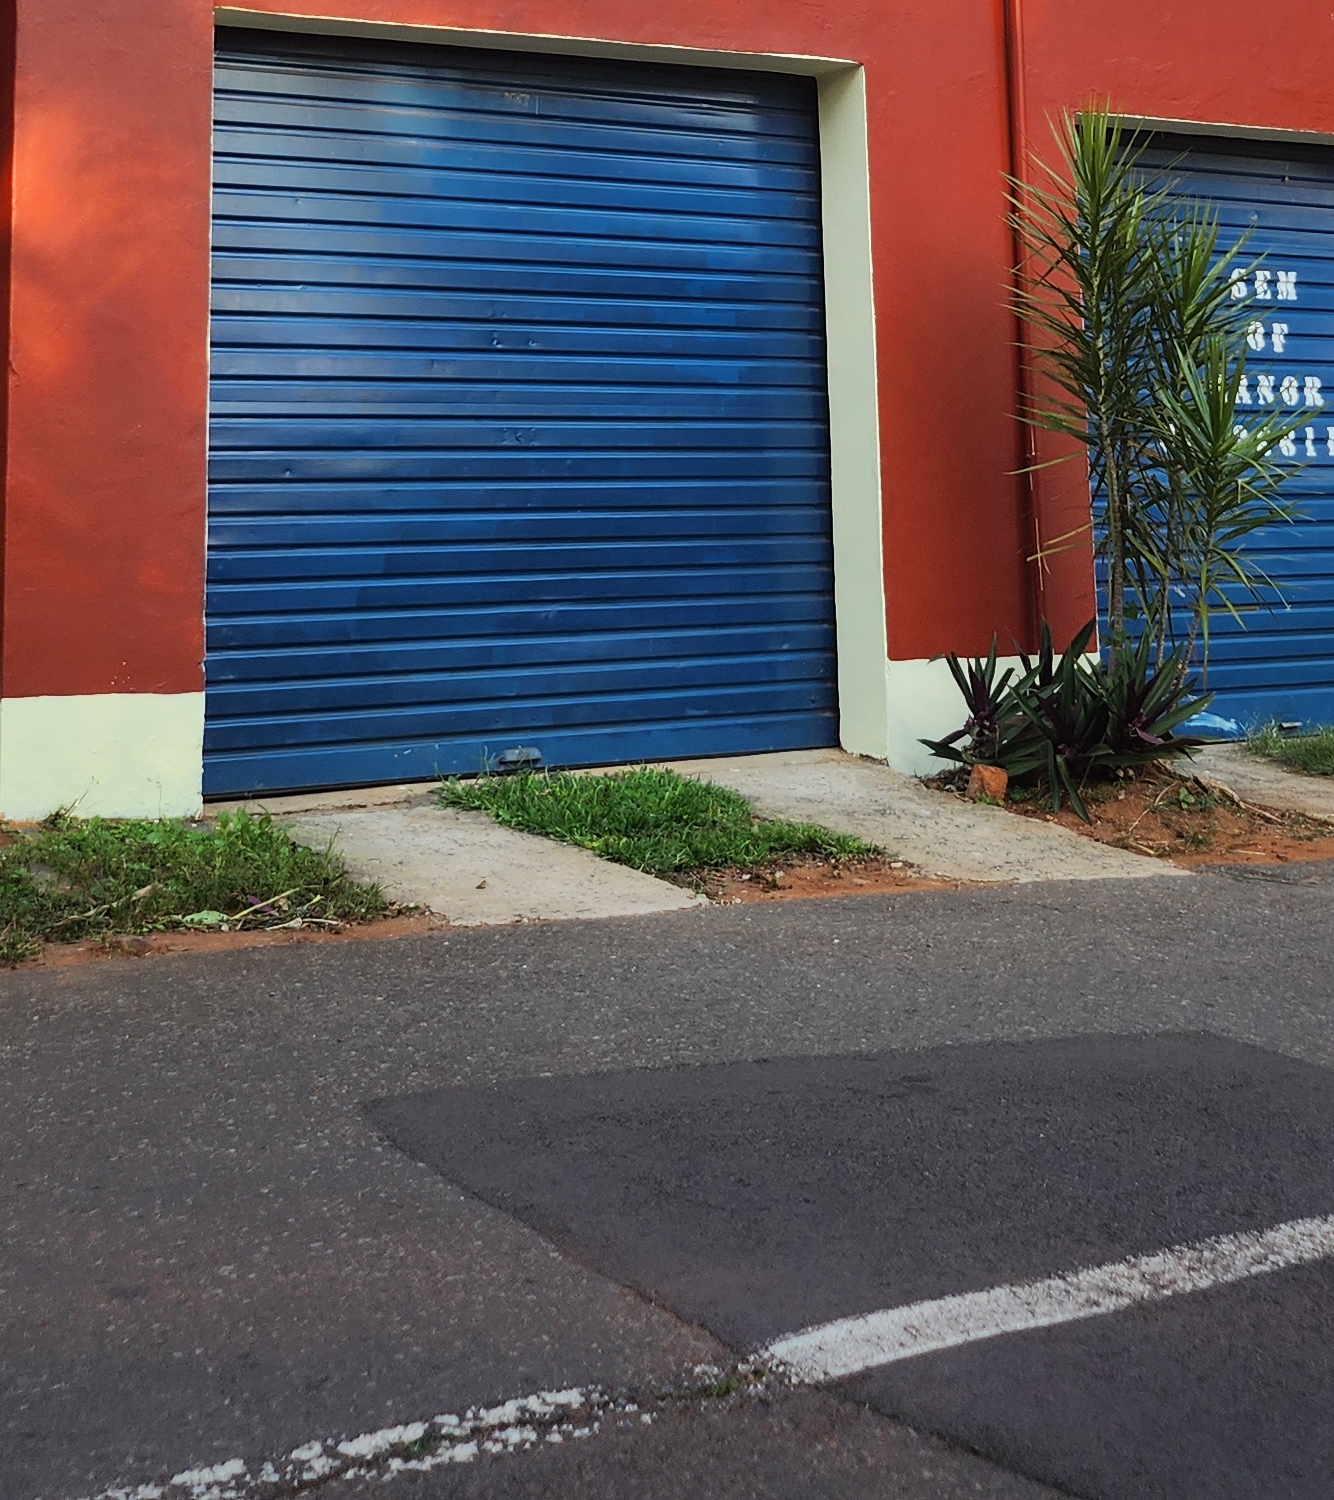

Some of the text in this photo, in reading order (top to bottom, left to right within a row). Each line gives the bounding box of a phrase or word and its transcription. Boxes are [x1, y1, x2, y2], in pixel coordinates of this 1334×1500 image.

[1228, 267, 1298, 300] GEM
[1247, 320, 1289, 353] OF
[1212, 373, 1325, 407] ANOR
